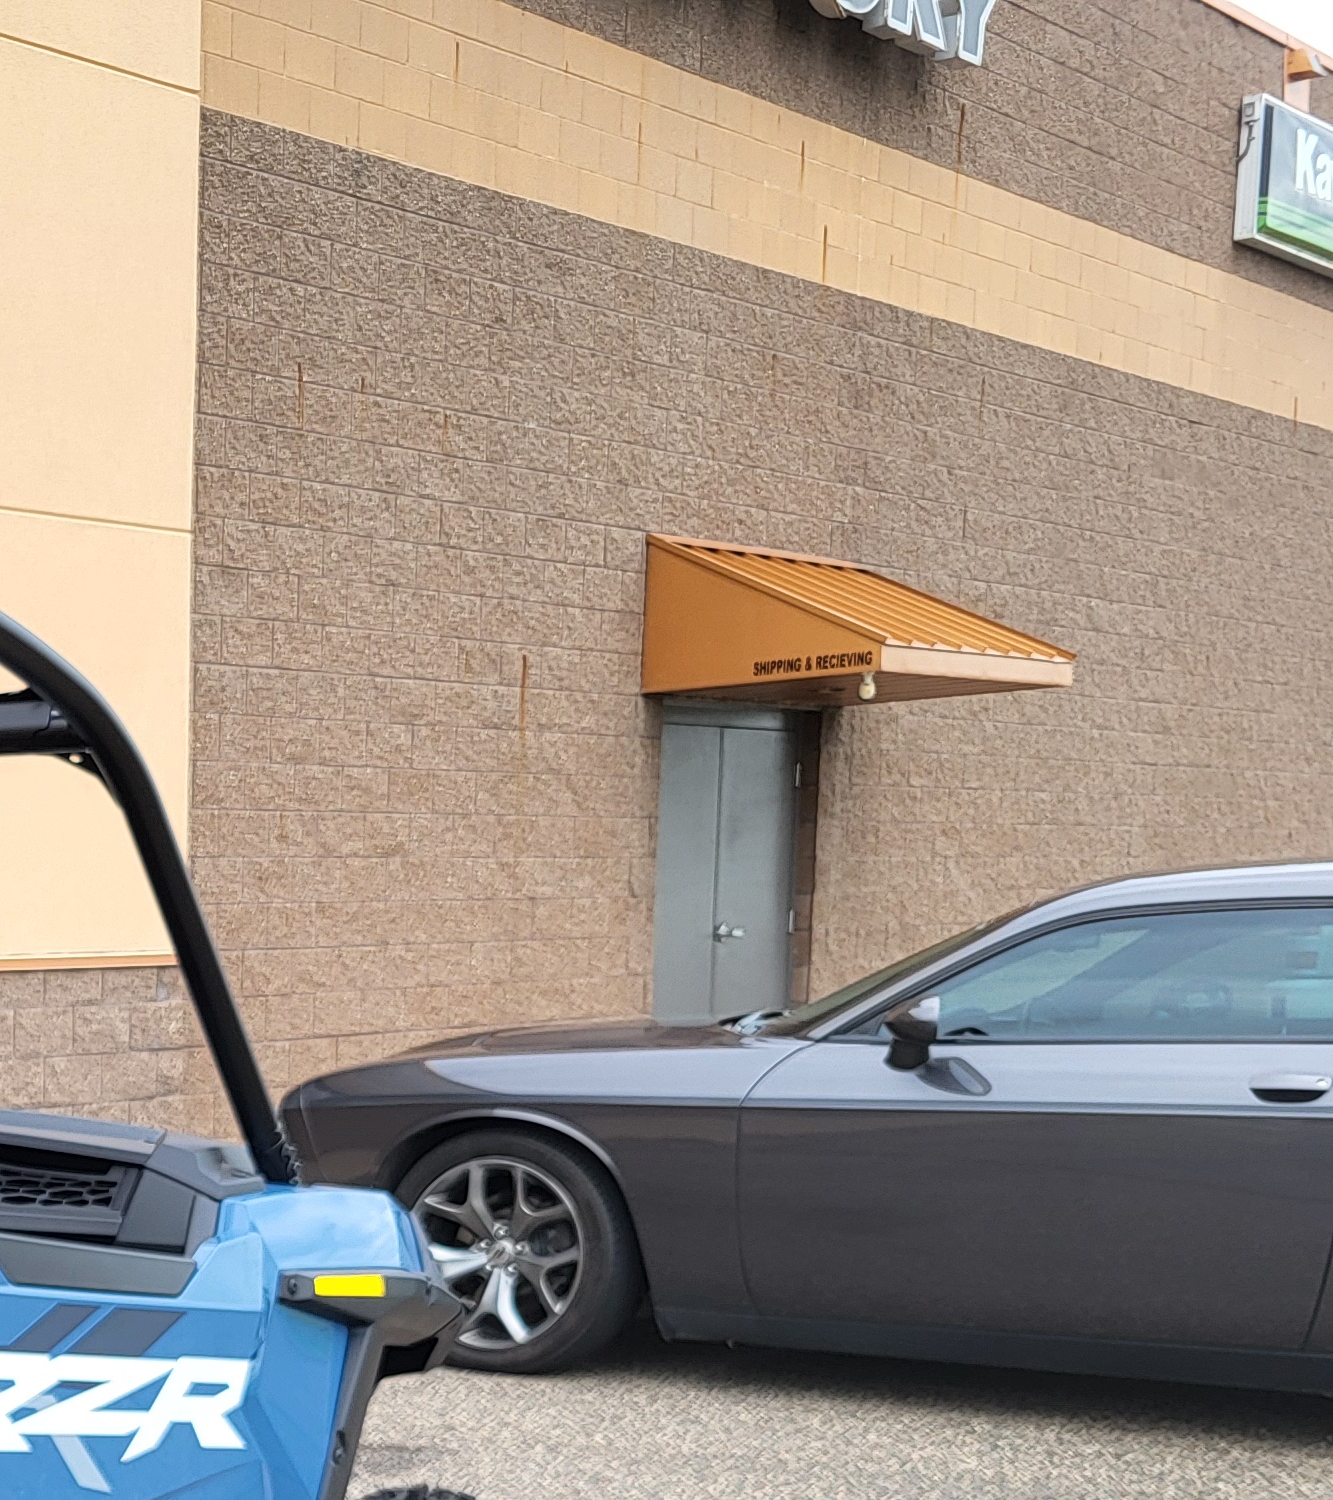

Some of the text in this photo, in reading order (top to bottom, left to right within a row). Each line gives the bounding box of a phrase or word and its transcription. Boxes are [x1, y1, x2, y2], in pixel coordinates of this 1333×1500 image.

[752, 650, 873, 676] SHIPPING & RECIEVING
